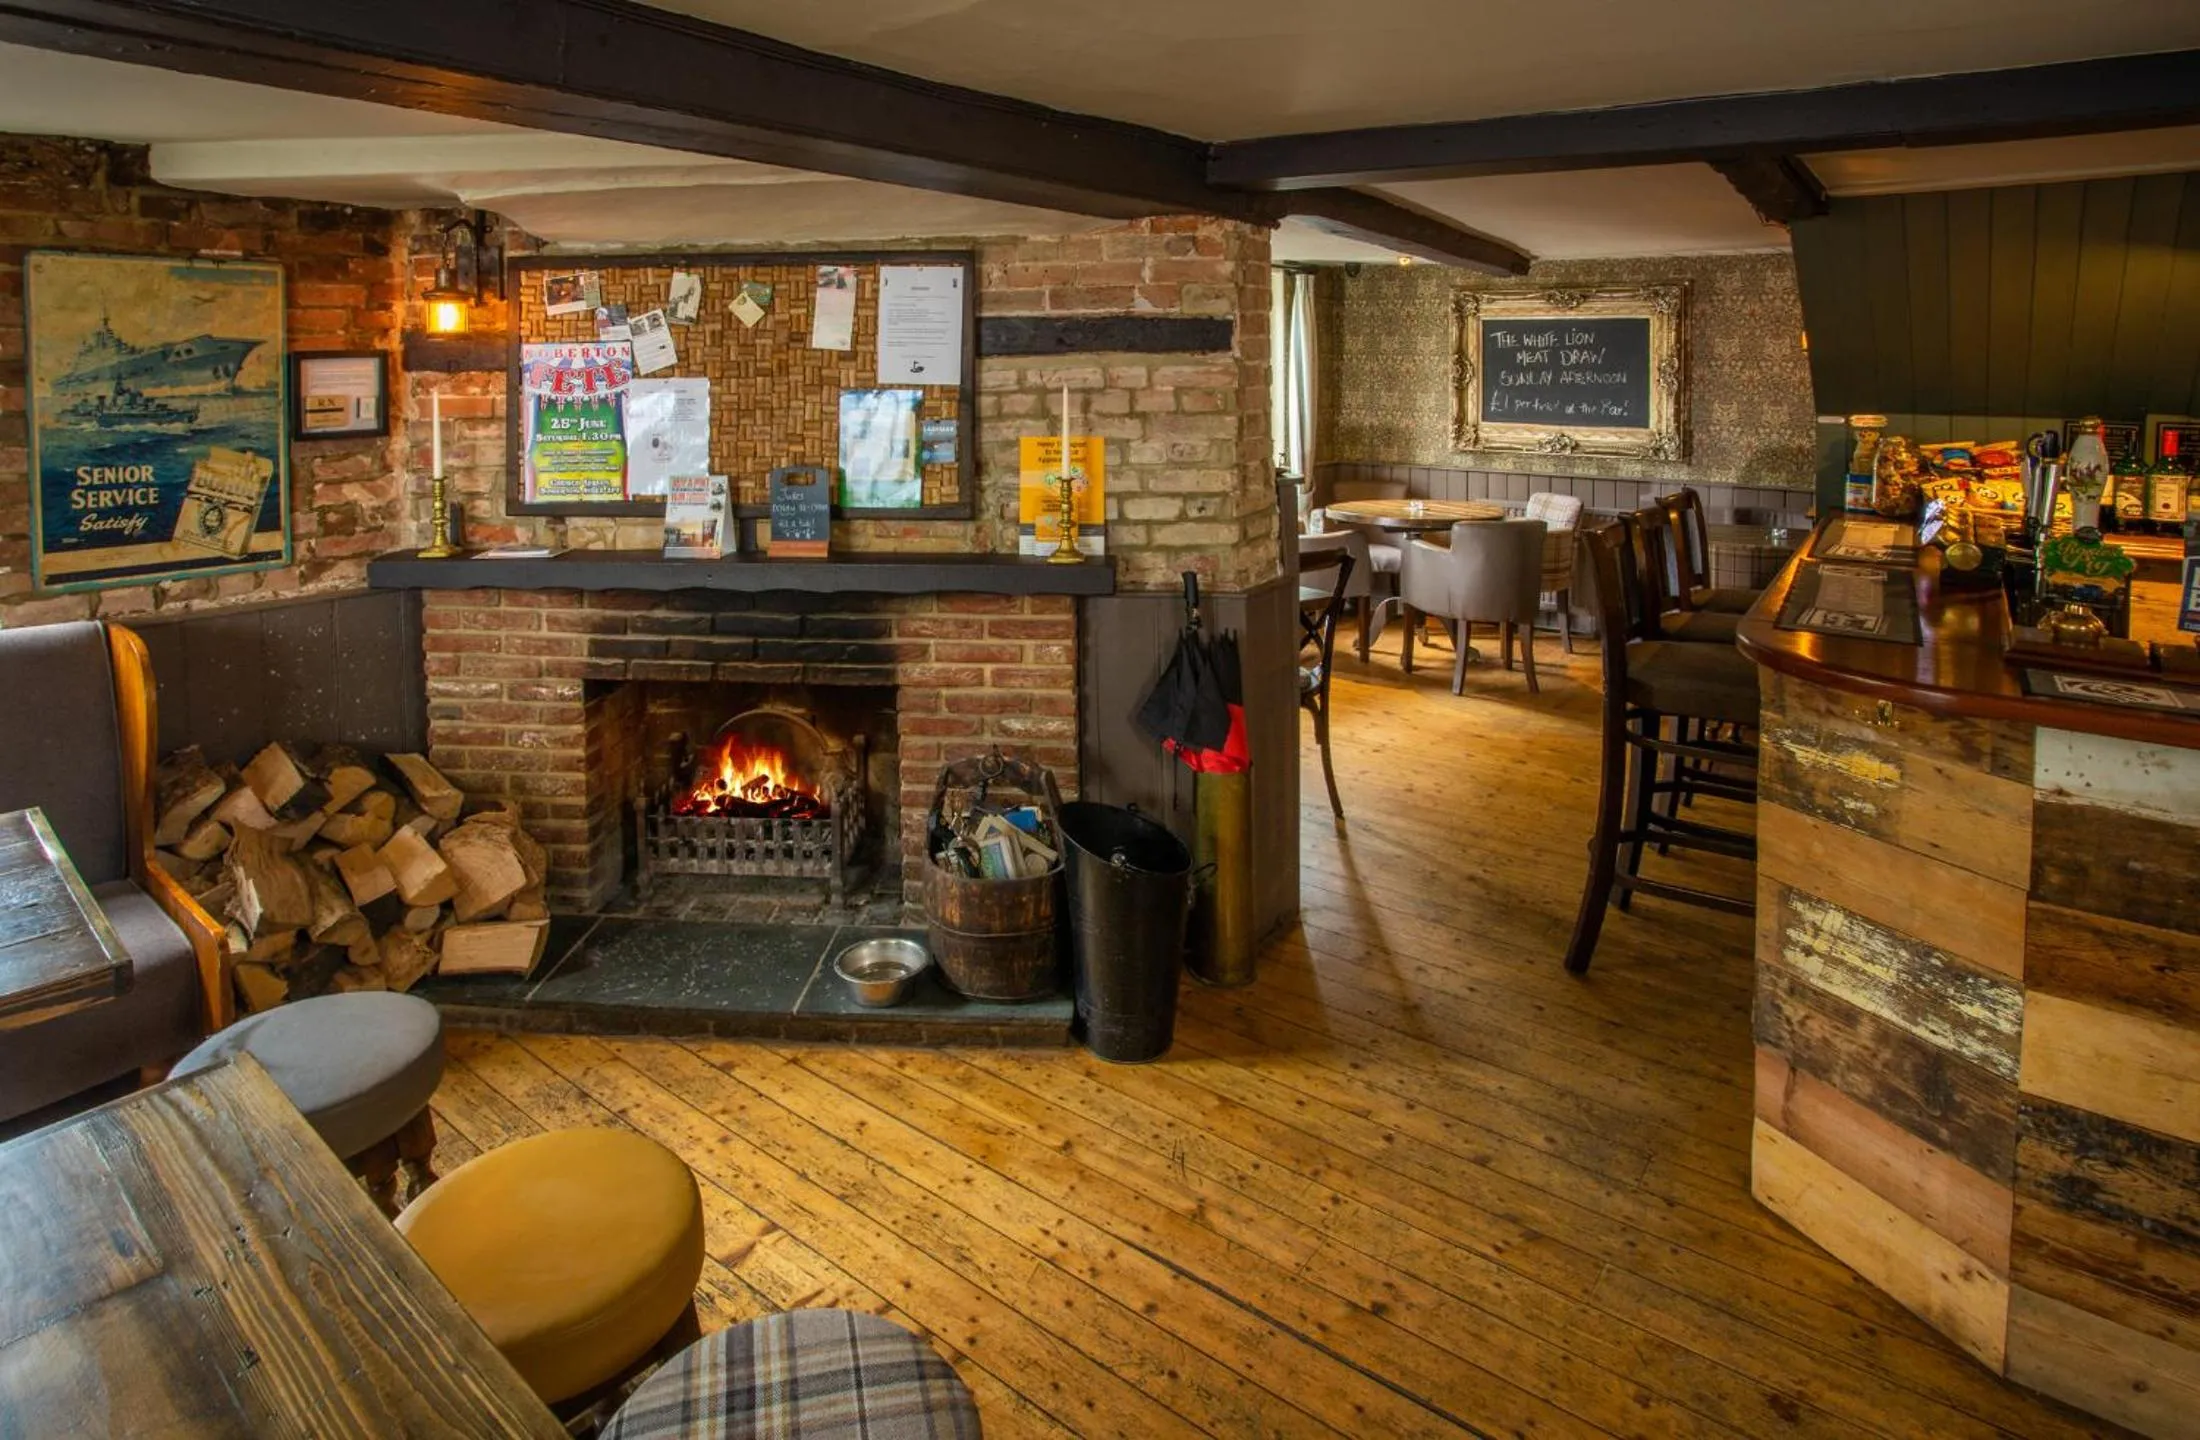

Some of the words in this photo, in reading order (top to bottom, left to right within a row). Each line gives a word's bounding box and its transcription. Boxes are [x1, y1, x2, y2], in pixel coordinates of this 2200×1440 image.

[1489, 331, 1519, 348] THE
[1523, 330, 1560, 348] WHITE
[1516, 349, 1549, 367] MEAT
[76, 465, 155, 486] SENIOR
[71, 487, 160, 509] SERVICE
[79, 513, 149, 535] Satisfy
